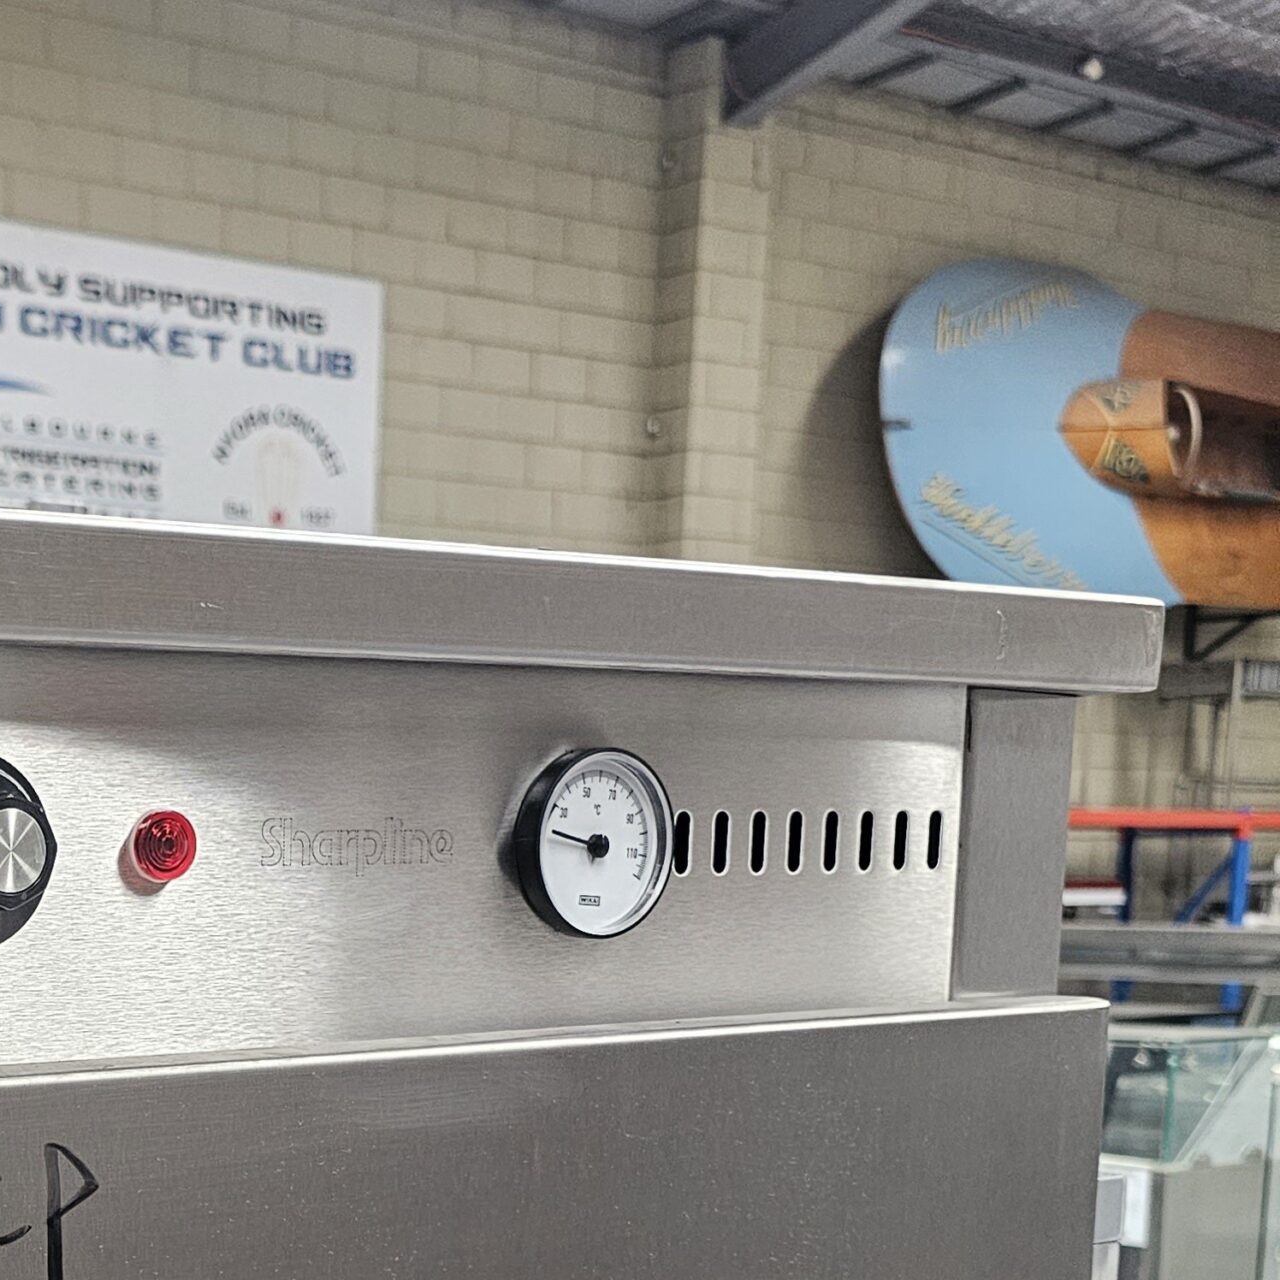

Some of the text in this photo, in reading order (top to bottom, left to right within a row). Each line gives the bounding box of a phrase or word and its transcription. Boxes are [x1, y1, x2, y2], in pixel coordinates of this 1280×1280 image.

[78, 273, 326, 336] SUPPORTING
[20, 305, 226, 362] CRICKET
[242, 335, 356, 380] CLUB
[583, 786, 591, 798] 50
[609, 788, 617, 801] 70
[559, 807, 568, 818] 30
[260, 817, 454, 877] Sharpline
[626, 847, 638, 859] 110
